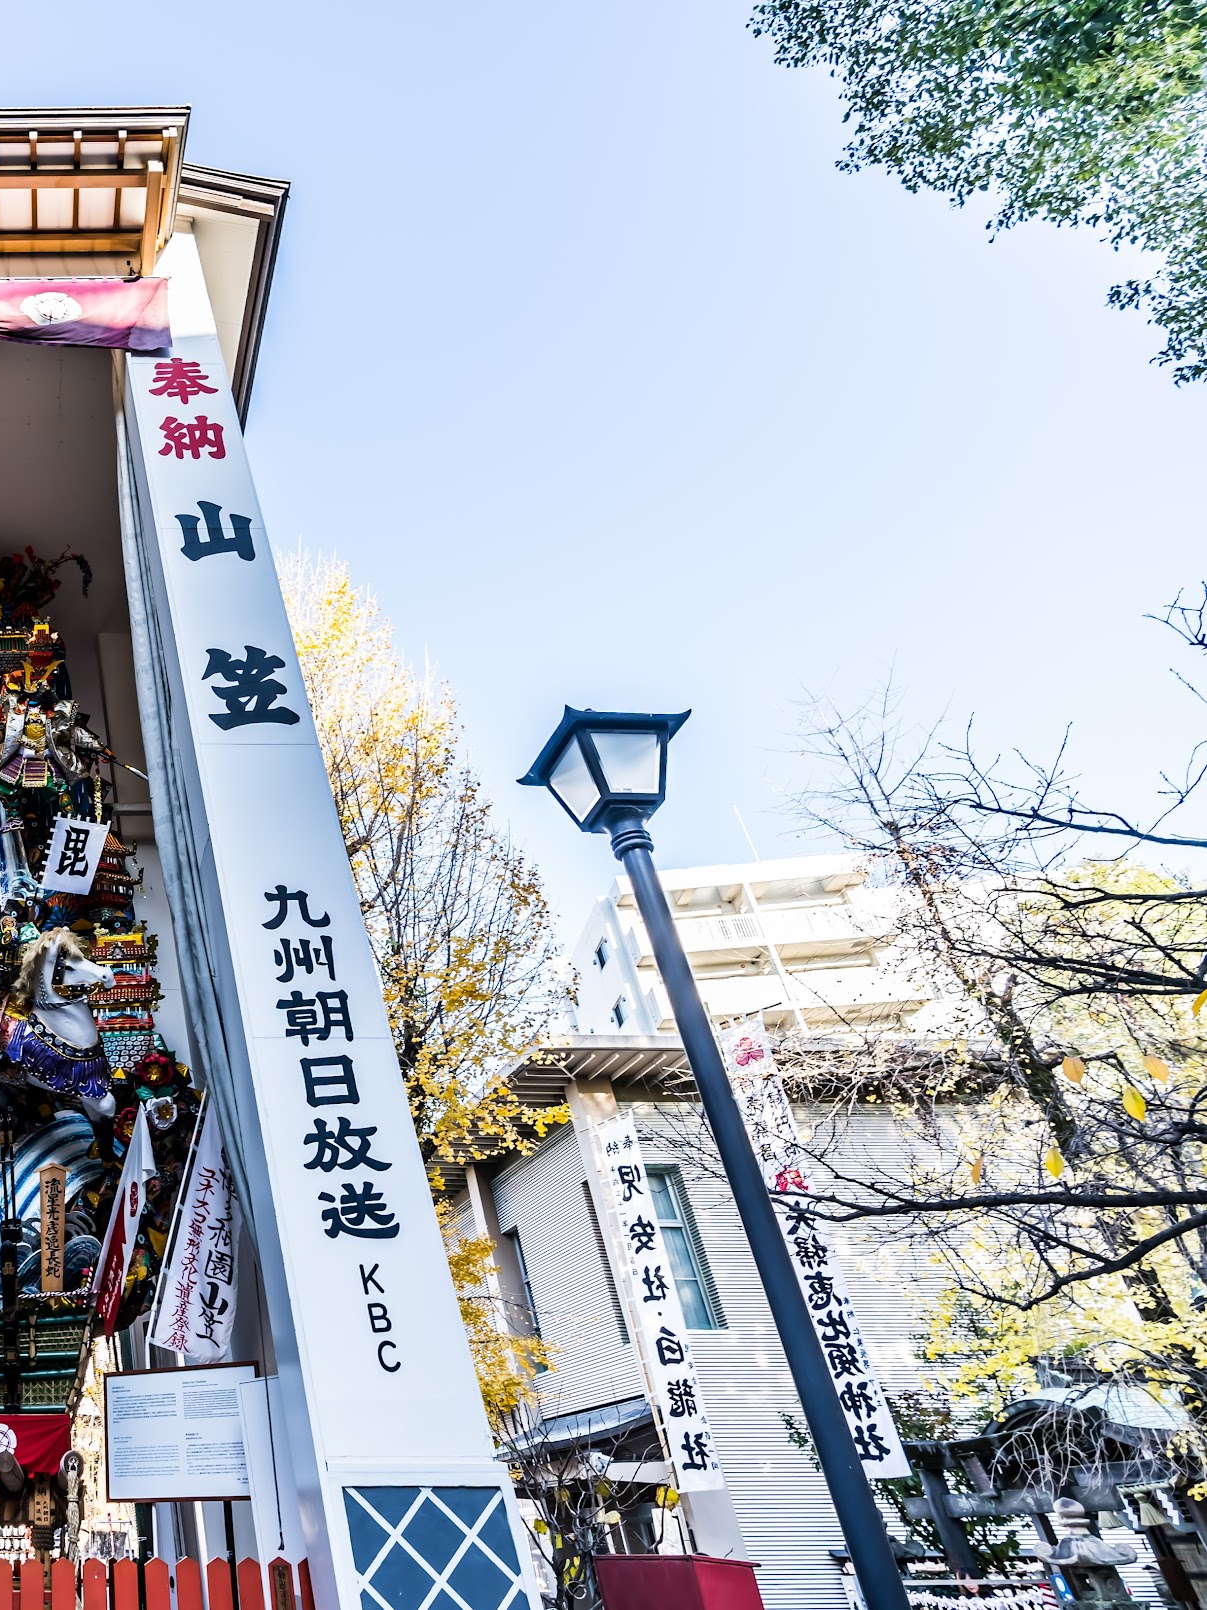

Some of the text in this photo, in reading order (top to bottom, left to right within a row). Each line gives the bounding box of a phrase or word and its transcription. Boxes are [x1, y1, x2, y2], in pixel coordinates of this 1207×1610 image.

[148, 357, 227, 460] 奉納
[174, 500, 301, 731] 山笠
[54, 825, 91, 877] 毘
[261, 883, 402, 1374] 九州朝日放送 KBC
